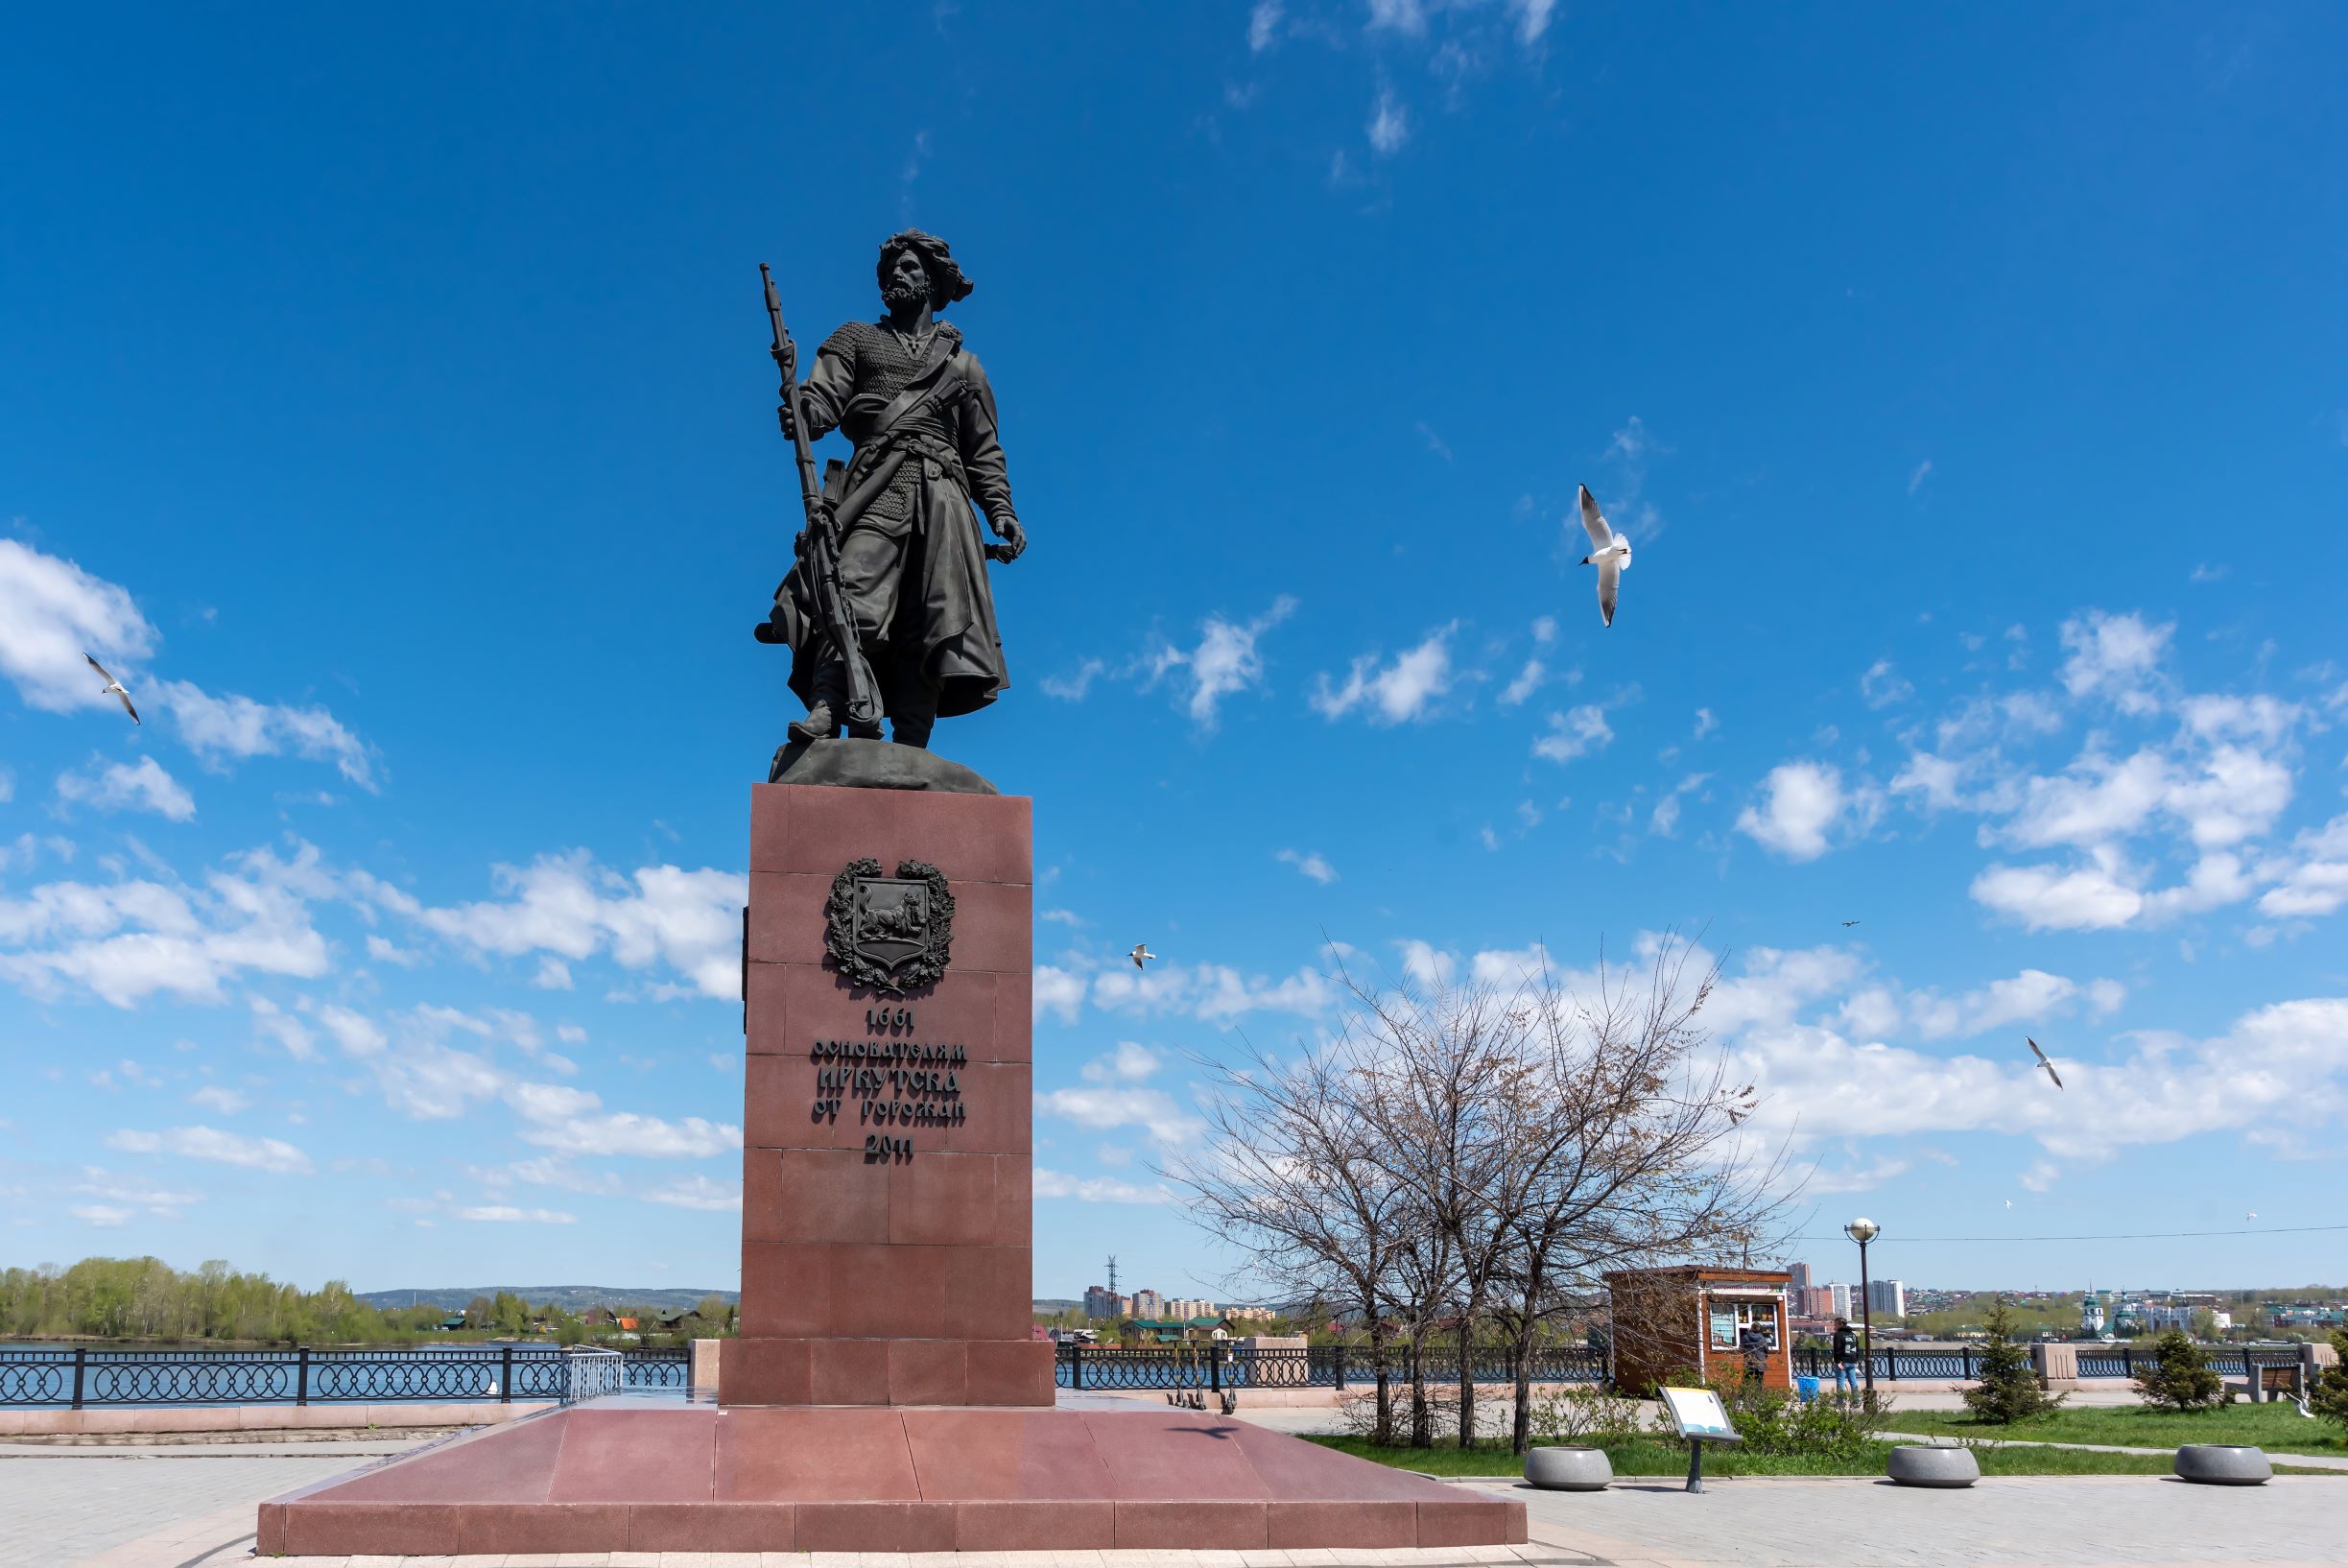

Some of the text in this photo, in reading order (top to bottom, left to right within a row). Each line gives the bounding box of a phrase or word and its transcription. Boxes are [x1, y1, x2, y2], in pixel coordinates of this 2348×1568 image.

[866, 1008, 914, 1028] 1661
[814, 1041, 968, 1060] ОСНОВАТЕЛЯМ
[818, 1067, 961, 1093] ИРКУТСКА
[814, 1098, 967, 1118] ОТ ГОРОЖАН
[865, 1134, 914, 1157] 2011
